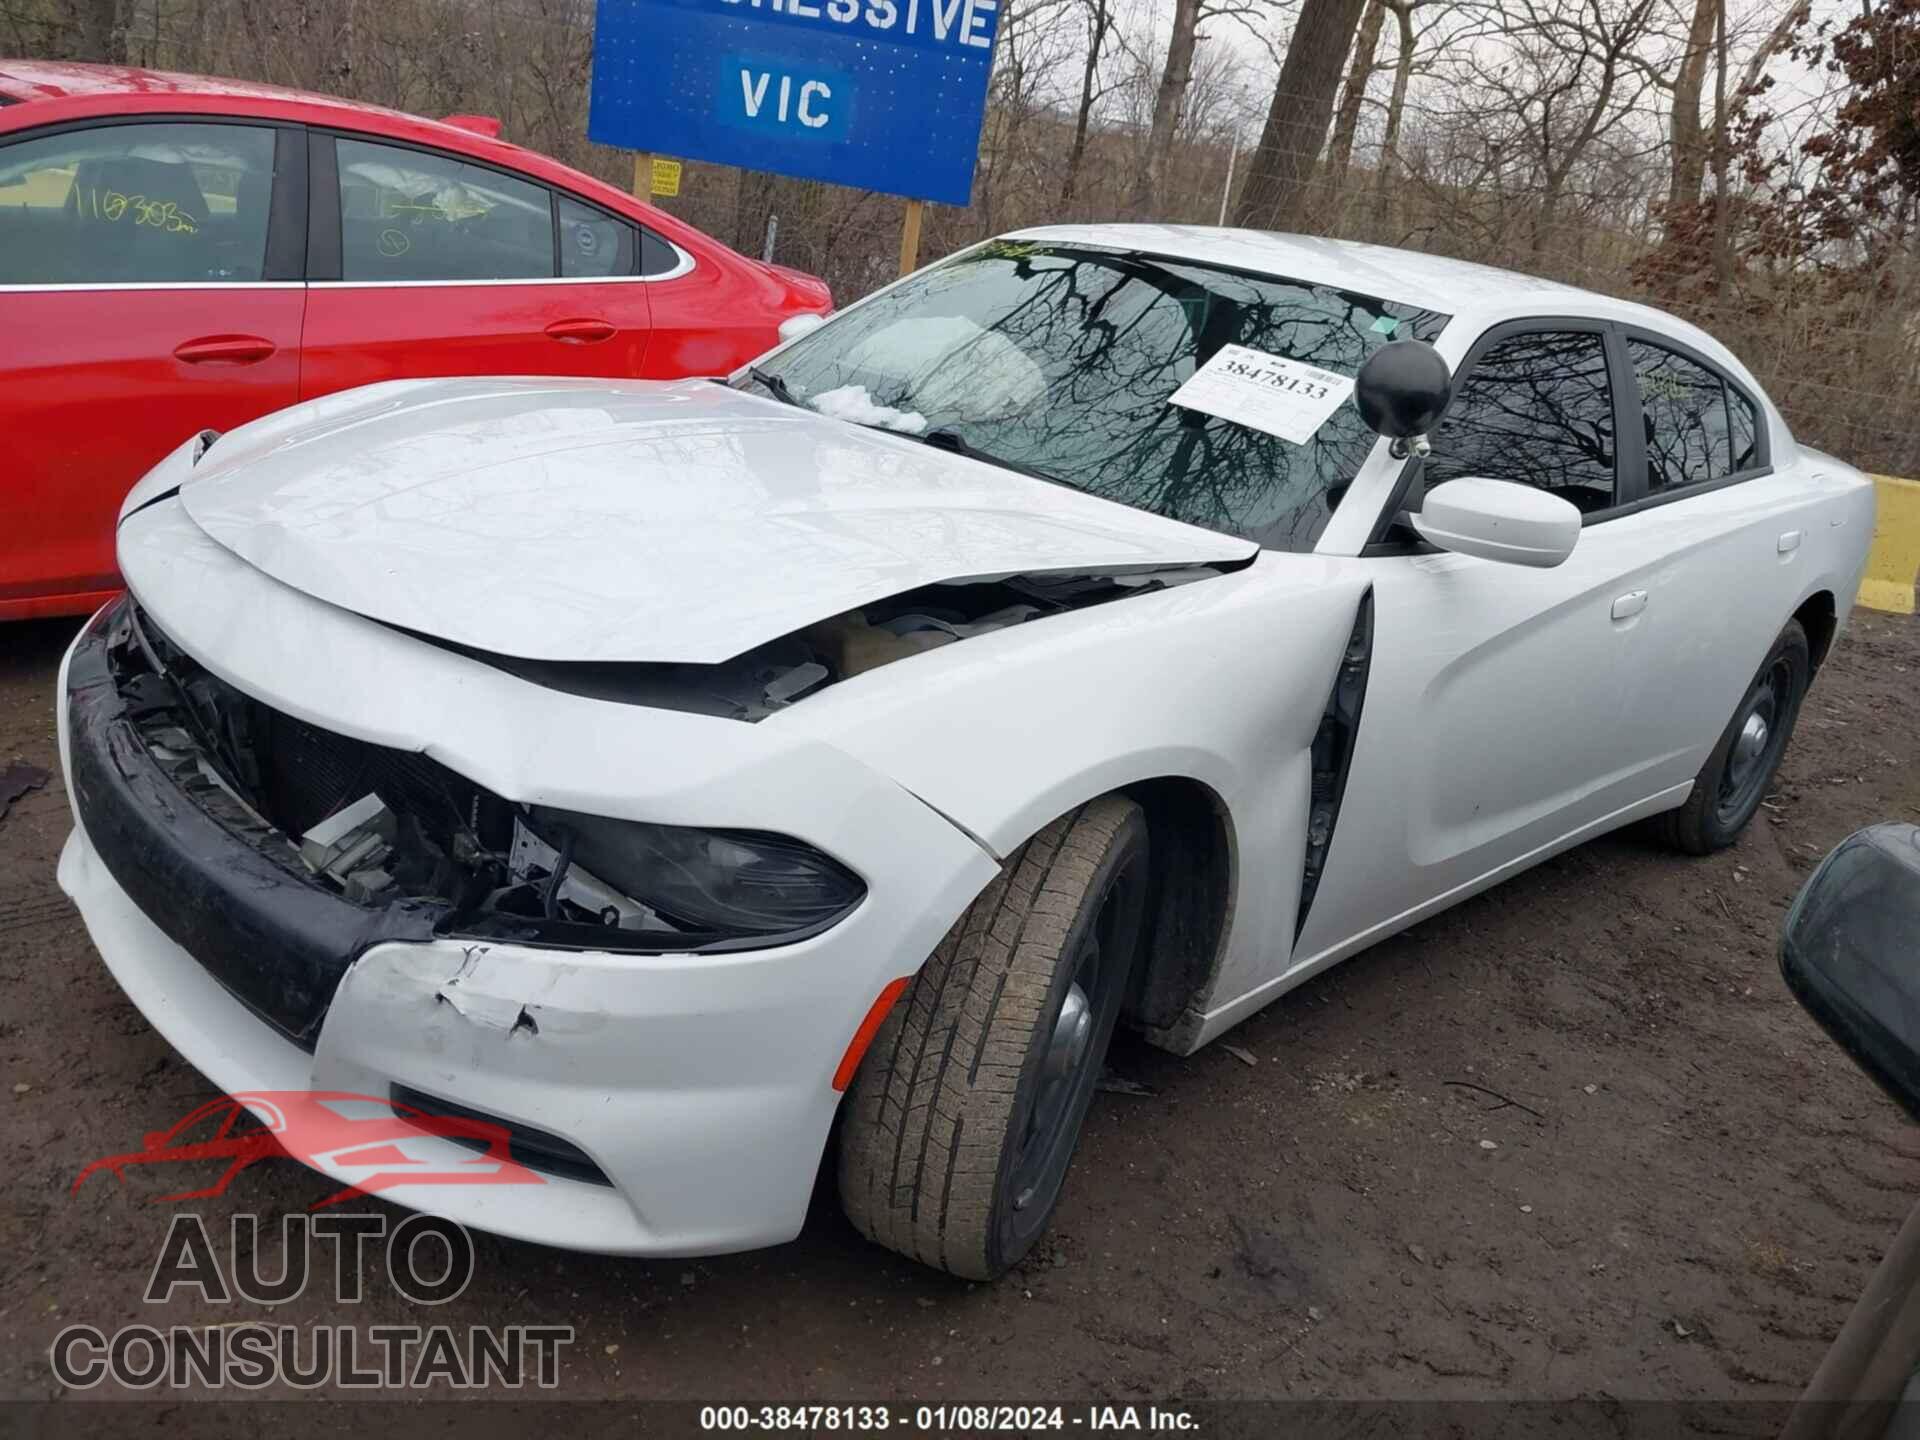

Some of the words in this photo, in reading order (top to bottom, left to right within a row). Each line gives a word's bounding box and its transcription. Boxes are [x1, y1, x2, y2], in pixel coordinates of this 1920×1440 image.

[722, 0, 998, 48] SSIVE
[740, 69, 831, 128] VIC
[1218, 360, 1328, 400] 38478133
